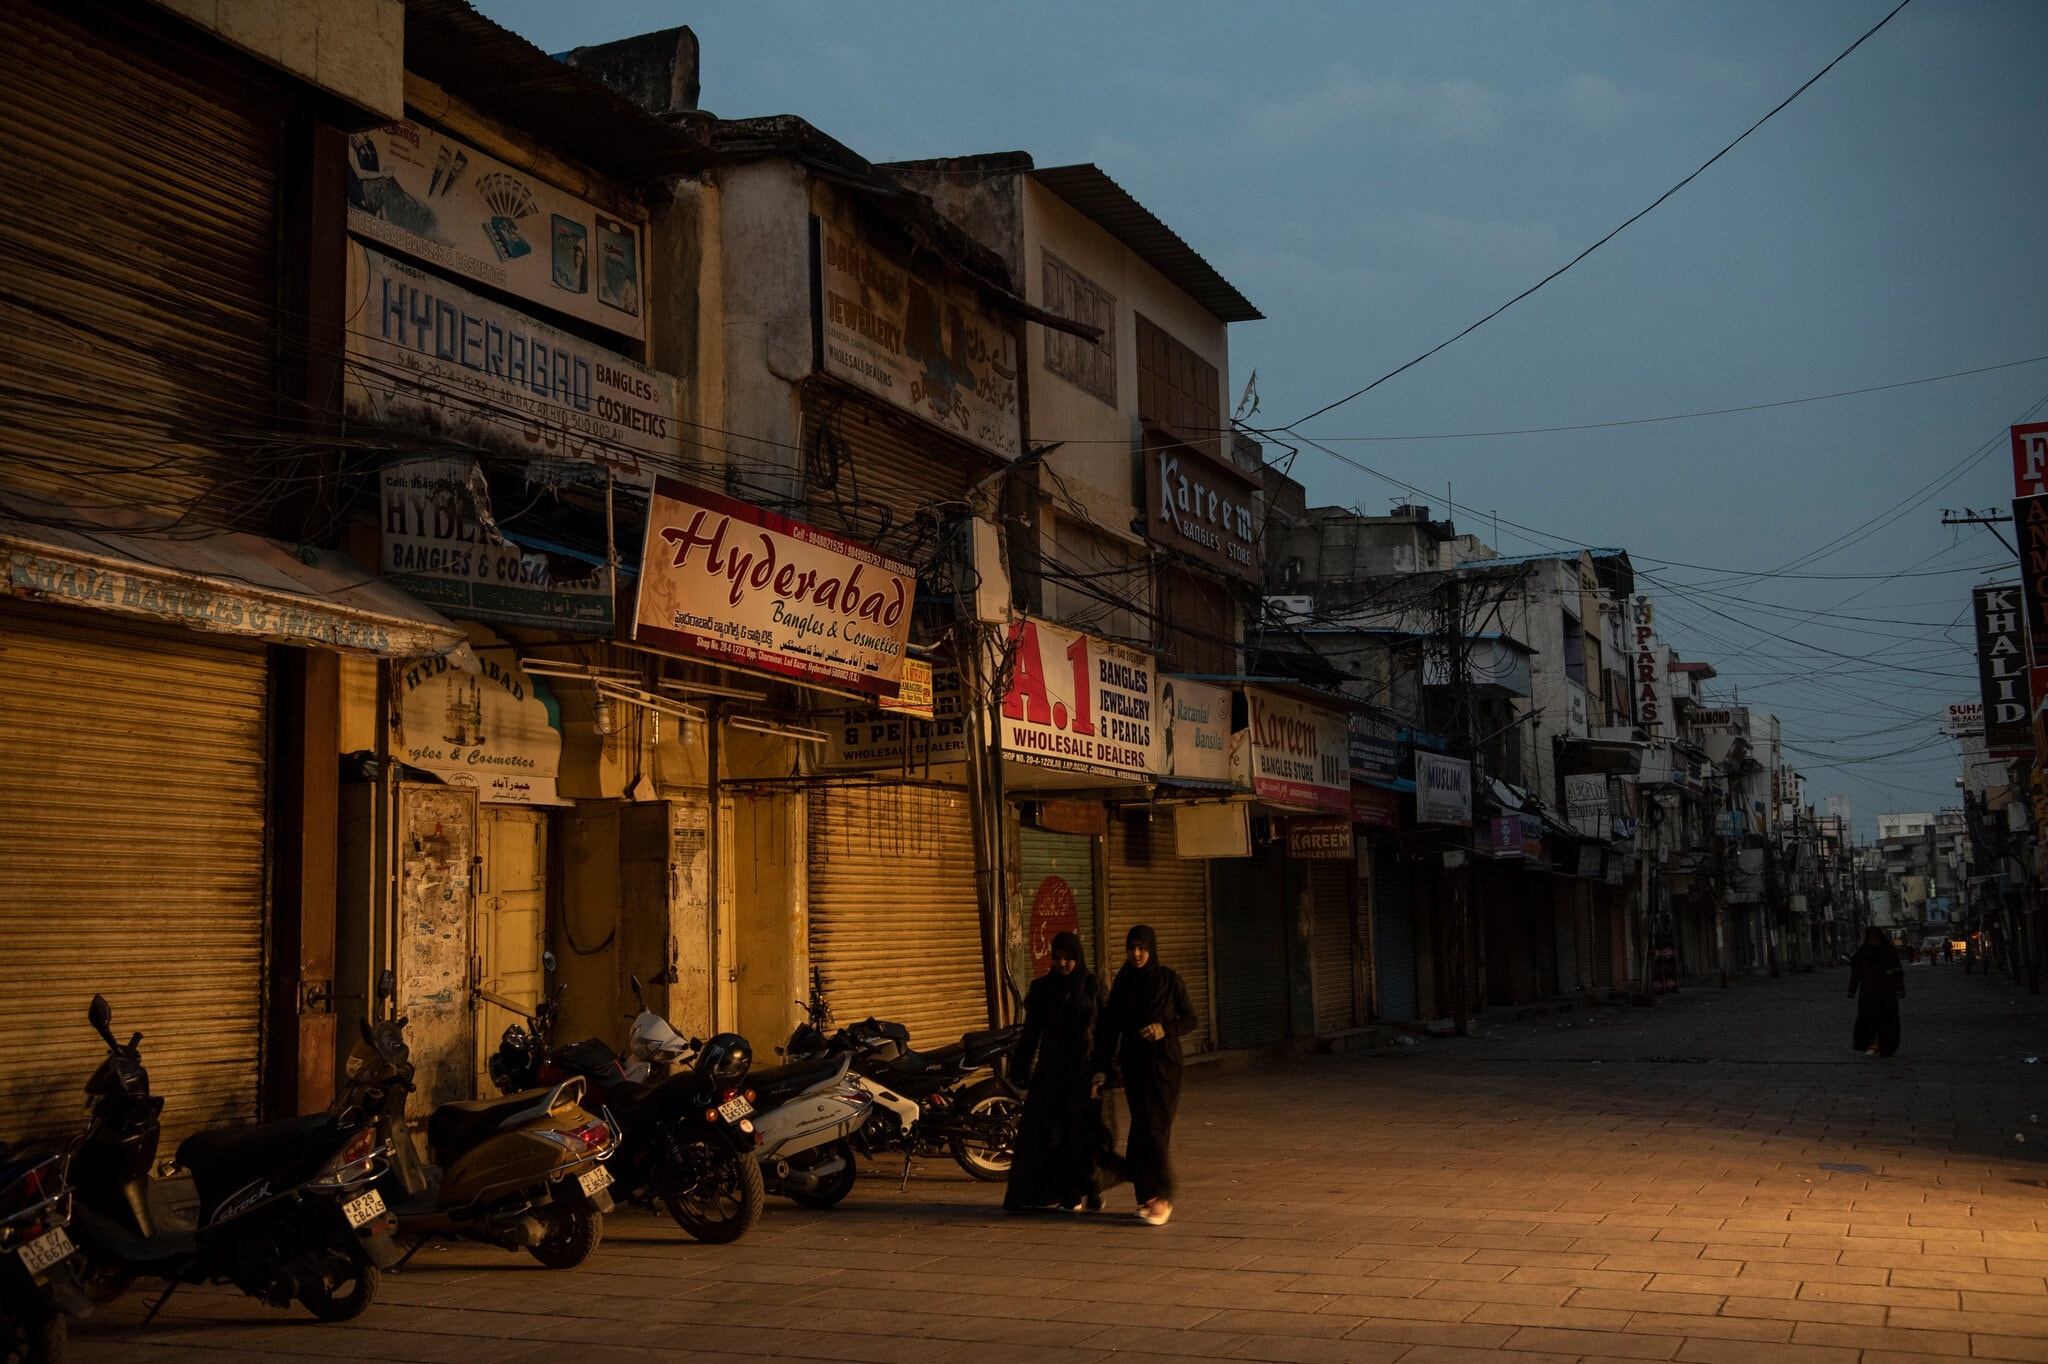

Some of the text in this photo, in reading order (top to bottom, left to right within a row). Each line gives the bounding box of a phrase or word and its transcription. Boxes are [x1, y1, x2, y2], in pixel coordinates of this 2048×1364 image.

[406, 231, 445, 264] BANGLES
[456, 253, 507, 287] COSMETICS
[827, 289, 902, 356] JEWELLERY
[383, 277, 593, 413] HYDERABAD
[596, 363, 652, 401] BANGLES
[828, 344, 893, 387] WHOLESALE DEALERS
[597, 395, 666, 440] COSMETICS
[910, 381, 970, 431] BAES
[387, 477, 408, 488] Cell:
[1157, 451, 1253, 543] Kareem
[1183, 520, 1251, 565] BANGLES STORE
[393, 543, 471, 577] BANGLES
[478, 554, 489, 578] &
[661, 511, 905, 627] Hyderabad
[11, 552, 115, 602] KHAJA
[122, 575, 243, 626] BANGLES
[771, 600, 899, 656] Bangles & Cosmetics
[696, 636, 710, 650] Shop
[784, 655, 794, 668] Lad
[1984, 590, 2026, 724] KHALID
[405, 656, 524, 701] HYDBAD
[1002, 617, 1095, 737] A.1
[1099, 659, 1148, 694] BANGLES
[1100, 689, 1150, 722] JEWELLERY
[1177, 699, 1210, 725] Ratanlal
[1949, 703, 1983, 715] SUHA
[844, 727, 859, 745] &
[1101, 718, 1150, 747] & PEARLS
[1250, 695, 1318, 760] Kareem
[450, 747, 461, 760] &
[467, 749, 535, 769] Cosmetics
[916, 741, 964, 754] DALER
[1013, 727, 1145, 768] WHOLESALE DEALERS
[1016, 754, 1026, 764] NO.
[1260, 754, 1314, 782] BANGLES STORE
[1427, 765, 1461, 792] MUSLIM
[1291, 833, 1351, 850] KAREEM
[1291, 849, 1351, 859] BANGLES STORE
[351, 1194, 375, 1213] AP 29
[353, 1199, 385, 1224] CB4145
[30, 1240, 71, 1270] GE6670
